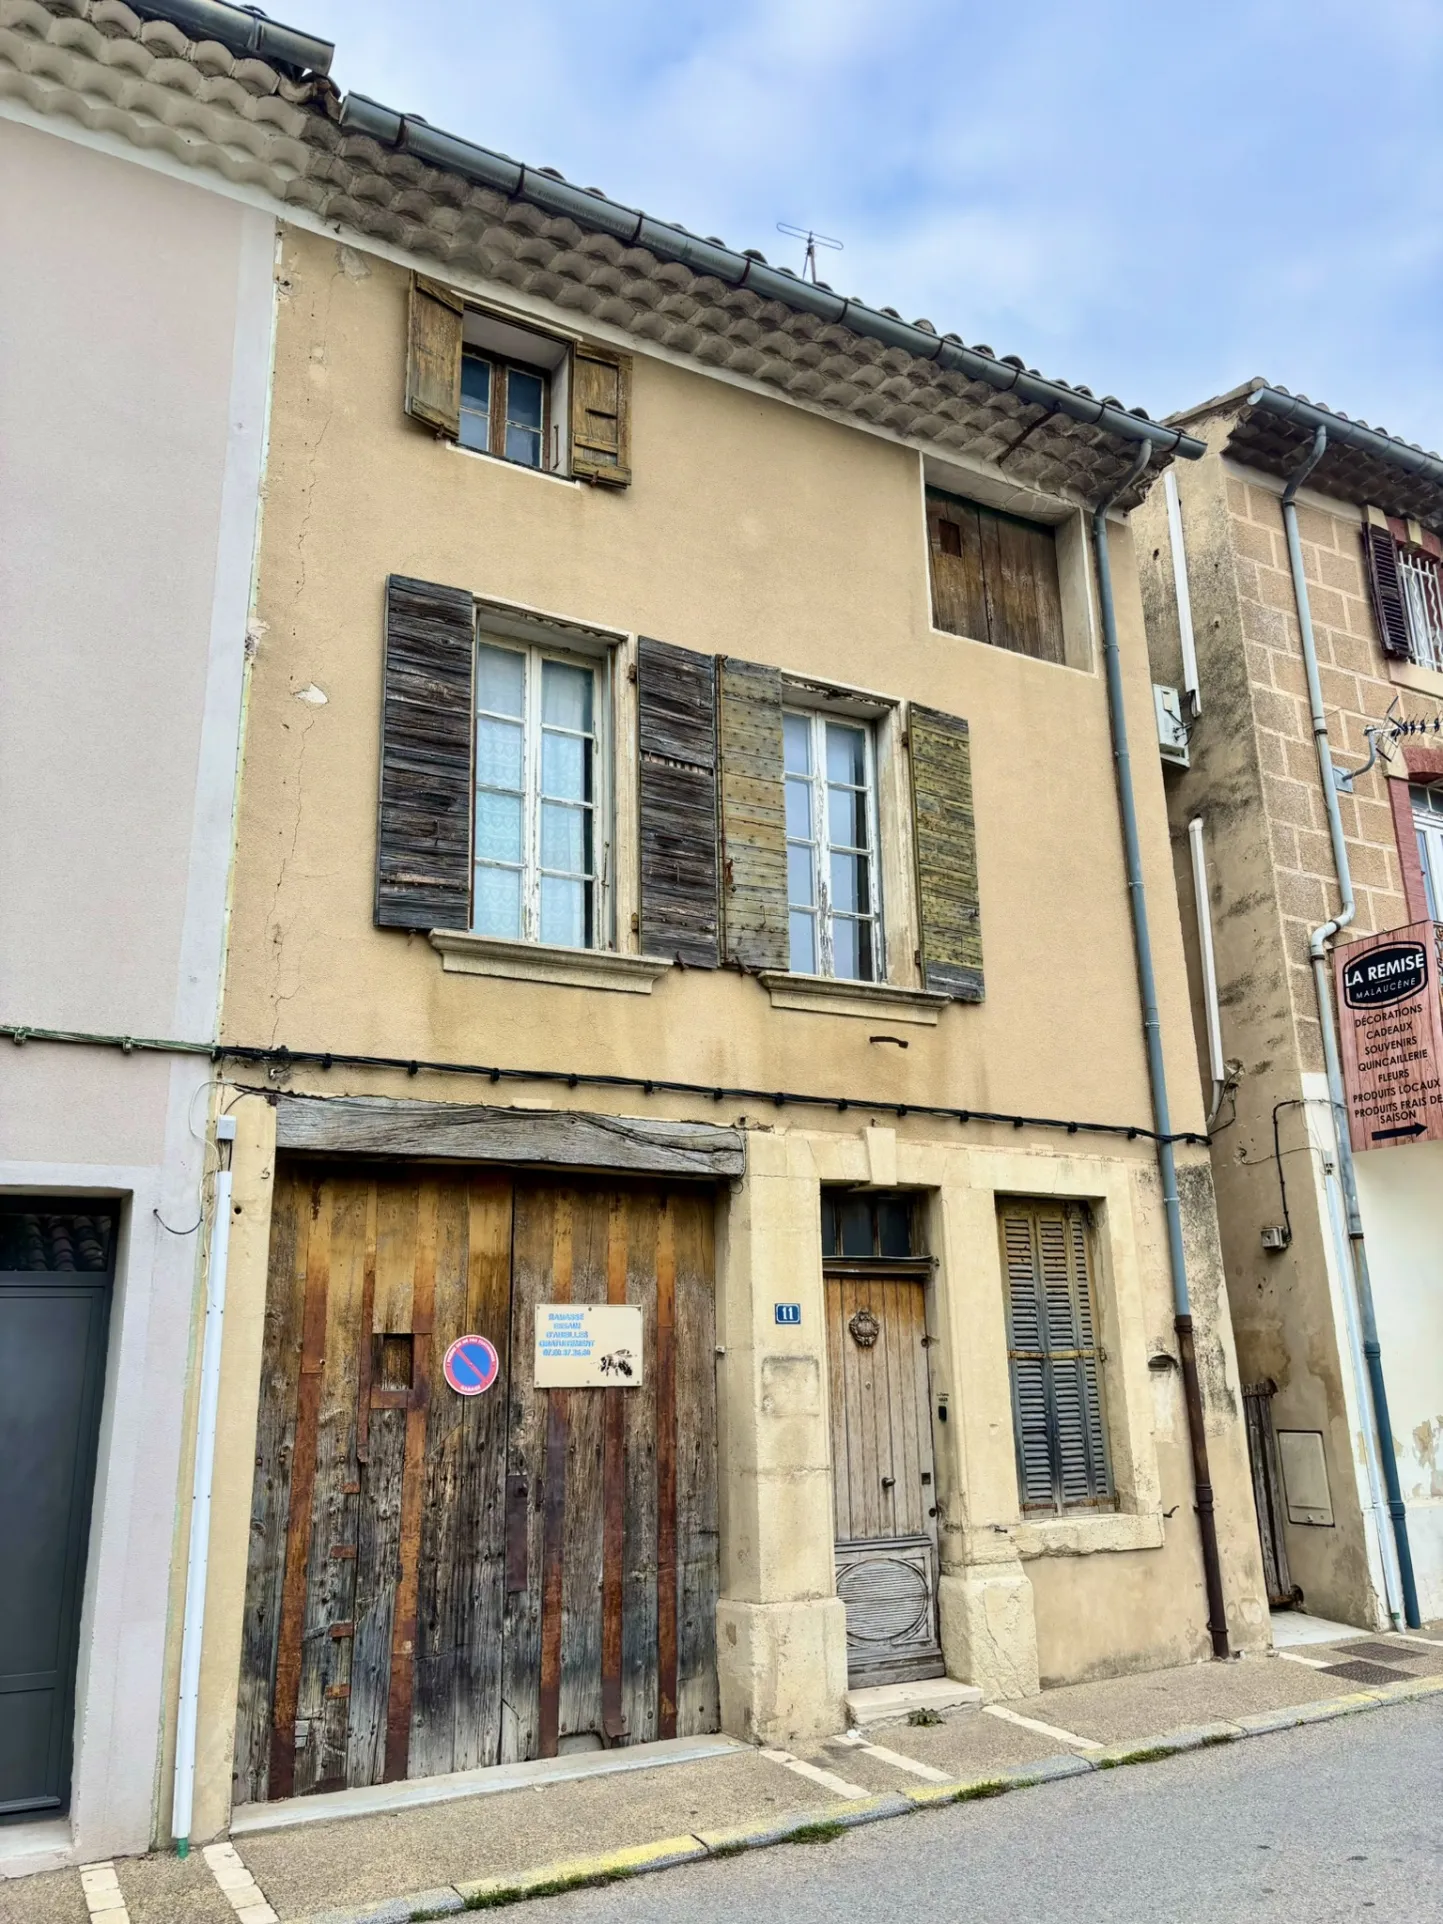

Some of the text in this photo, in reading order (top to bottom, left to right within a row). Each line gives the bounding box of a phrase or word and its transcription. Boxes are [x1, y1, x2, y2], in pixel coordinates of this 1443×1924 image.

[1345, 953, 1425, 987] LA REMISE
[1354, 1004, 1423, 1028] DÉCORATIONS
[1366, 1021, 1413, 1040] CADEAUX
[1365, 1036, 1418, 1056] SOUVENIRS
[1358, 1049, 1428, 1072] QUINCAILLERIE
[1378, 1069, 1410, 1084] FLEURS
[1353, 1078, 1441, 1103] PRODUITS LOCAUX
[1354, 1093, 1443, 1118] PRODUITS FRAIS DE
[1380, 1109, 1416, 1124] SAISON
[782, 1306, 794, 1320] 11
